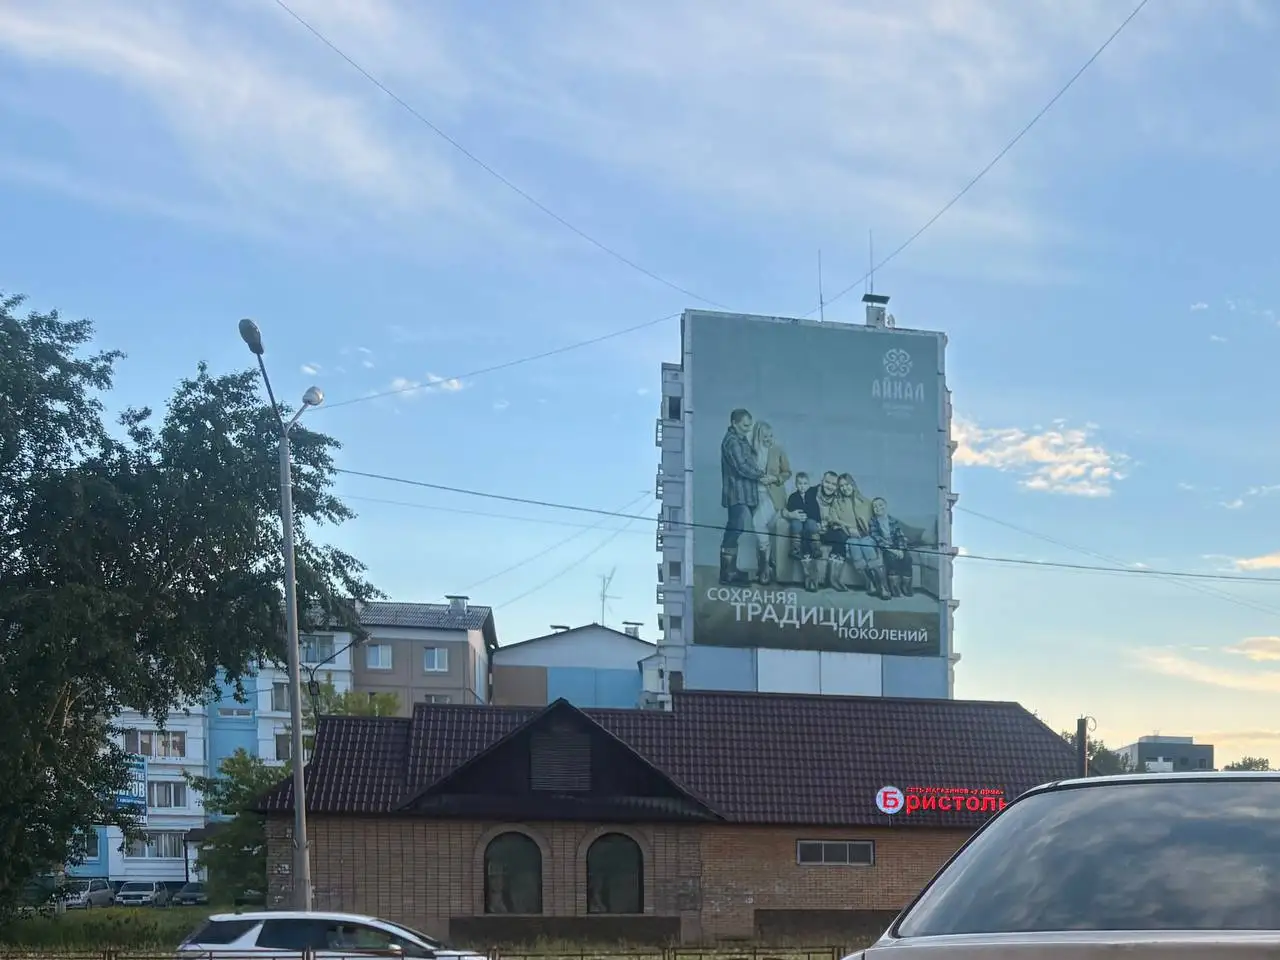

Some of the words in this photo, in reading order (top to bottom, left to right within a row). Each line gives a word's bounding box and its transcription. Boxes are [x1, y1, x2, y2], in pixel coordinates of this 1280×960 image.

[707, 587, 797, 606] СОХРАНЯЯ
[731, 603, 874, 630] ТРАДИЦИИ
[839, 626, 928, 643] ПОКОЛЕНИЙ
